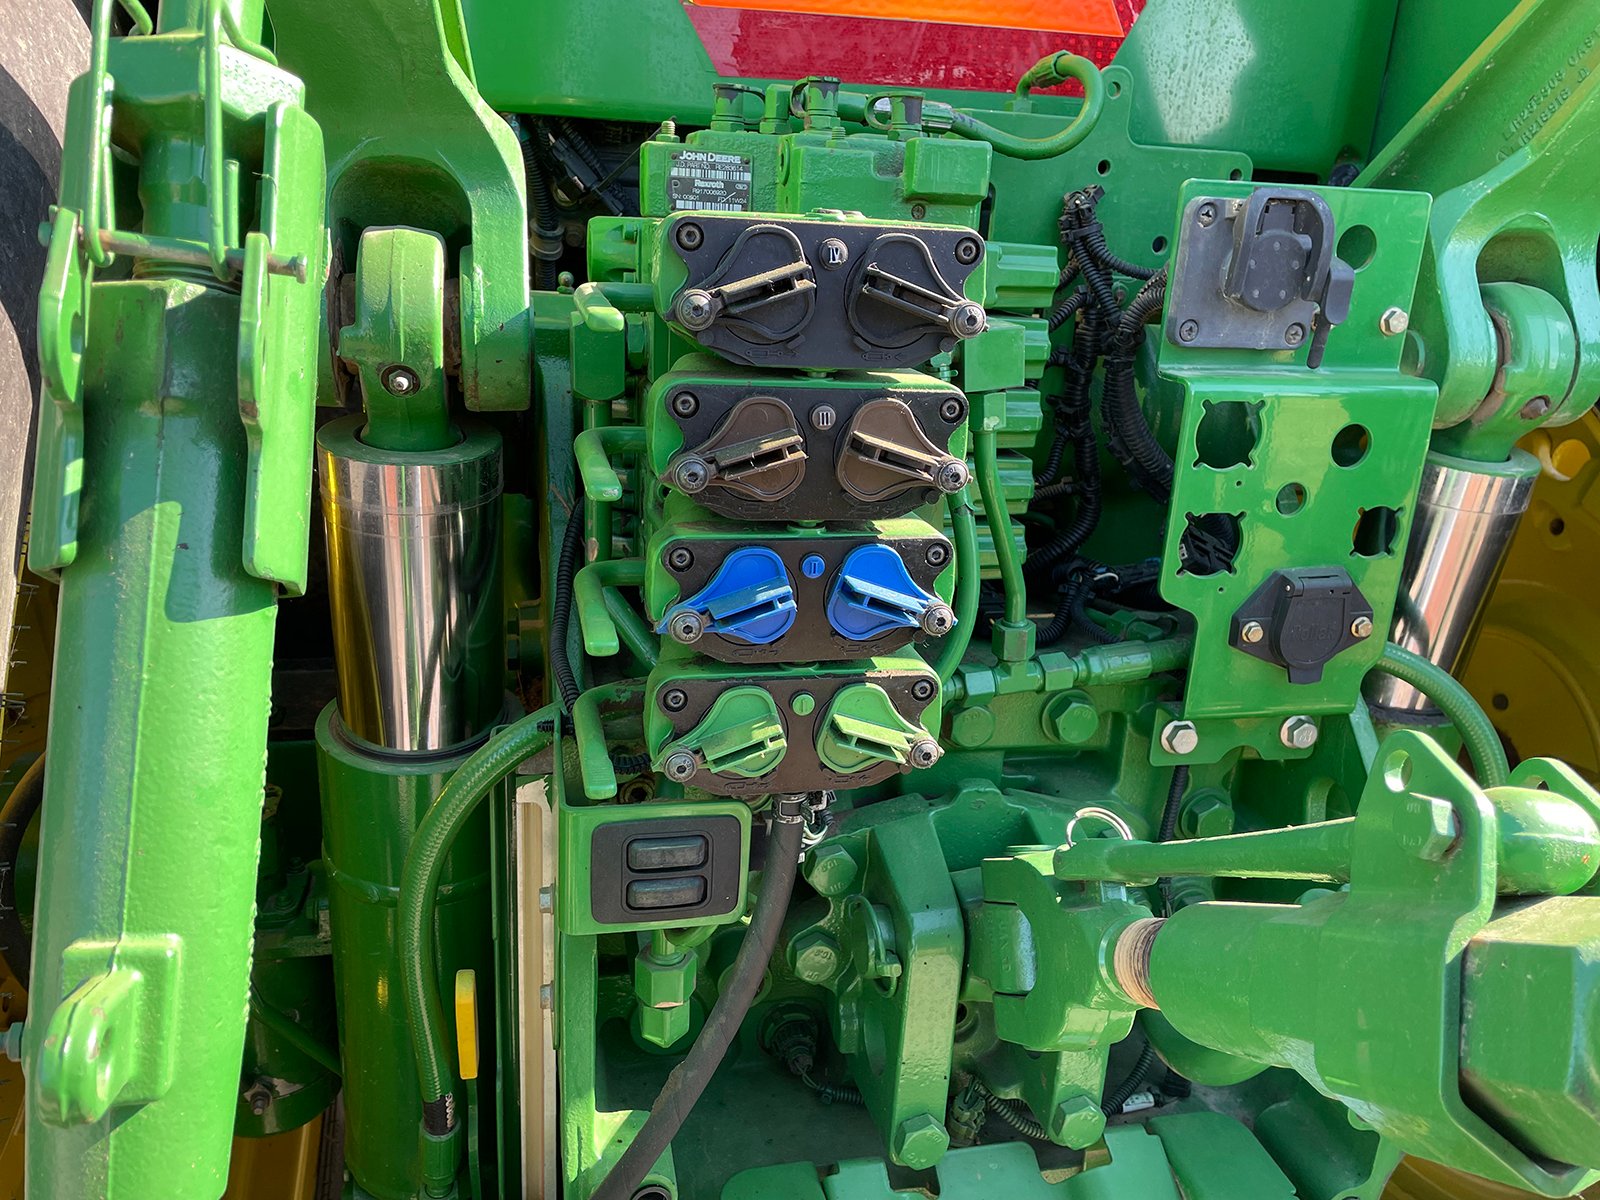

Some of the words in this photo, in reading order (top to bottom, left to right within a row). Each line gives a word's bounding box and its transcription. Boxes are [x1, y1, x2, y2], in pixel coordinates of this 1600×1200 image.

[679, 150, 707, 161] JOHN
[707, 152, 741, 164] DEERE
[694, 179, 724, 188] Rexroth
[818, 410, 832, 427] III
